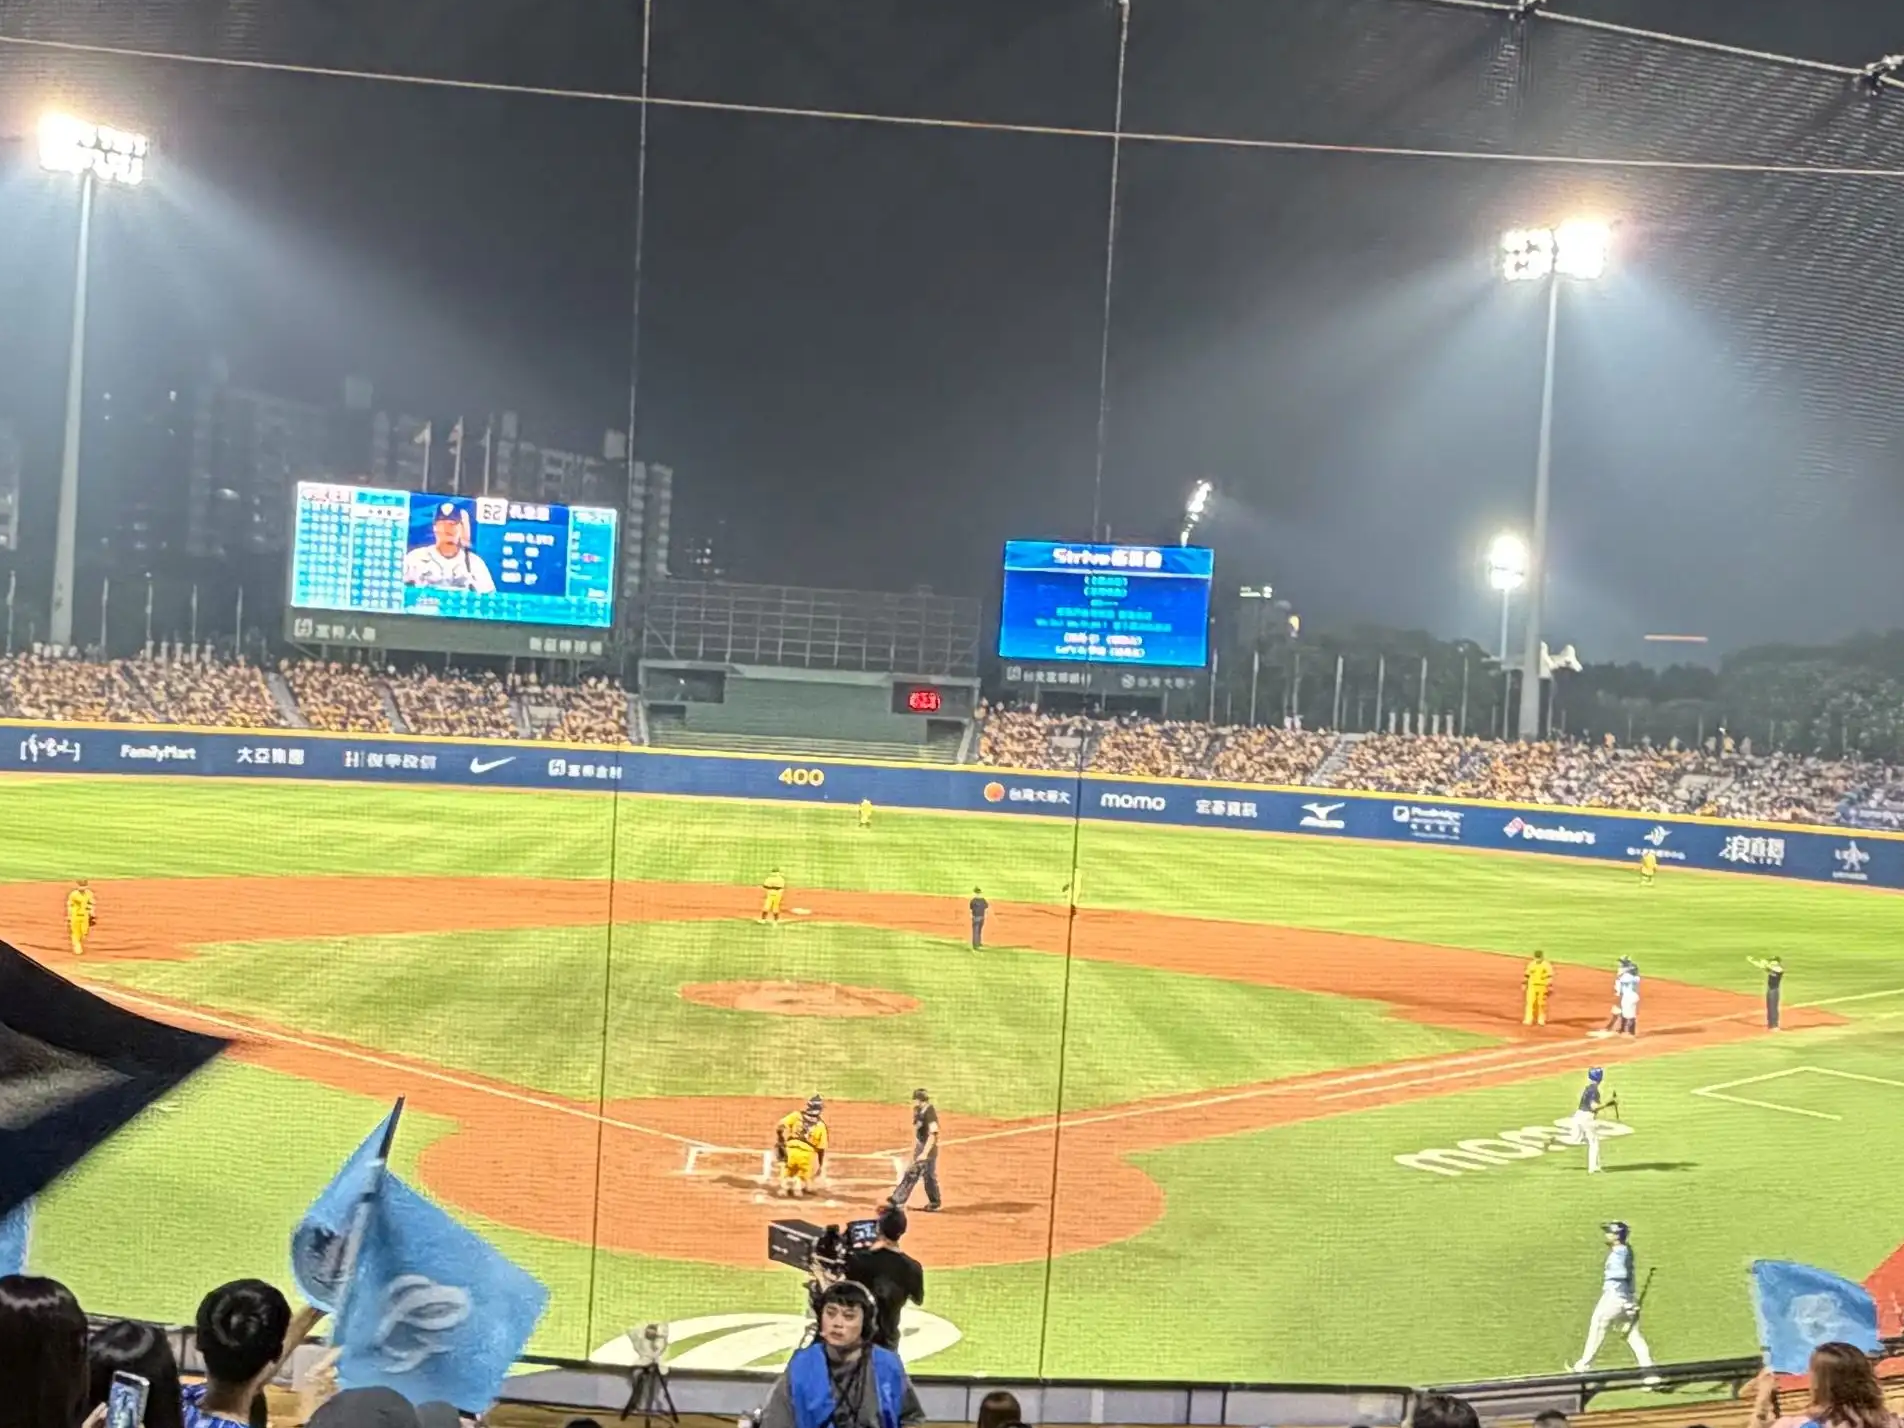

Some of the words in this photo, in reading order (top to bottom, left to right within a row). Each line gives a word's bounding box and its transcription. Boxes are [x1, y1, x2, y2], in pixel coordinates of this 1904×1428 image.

[120, 744, 196, 763] FamilyMart
[779, 767, 824, 786] 400
[1100, 792, 1166, 811] momo
[1523, 825, 1595, 845] Domino's
